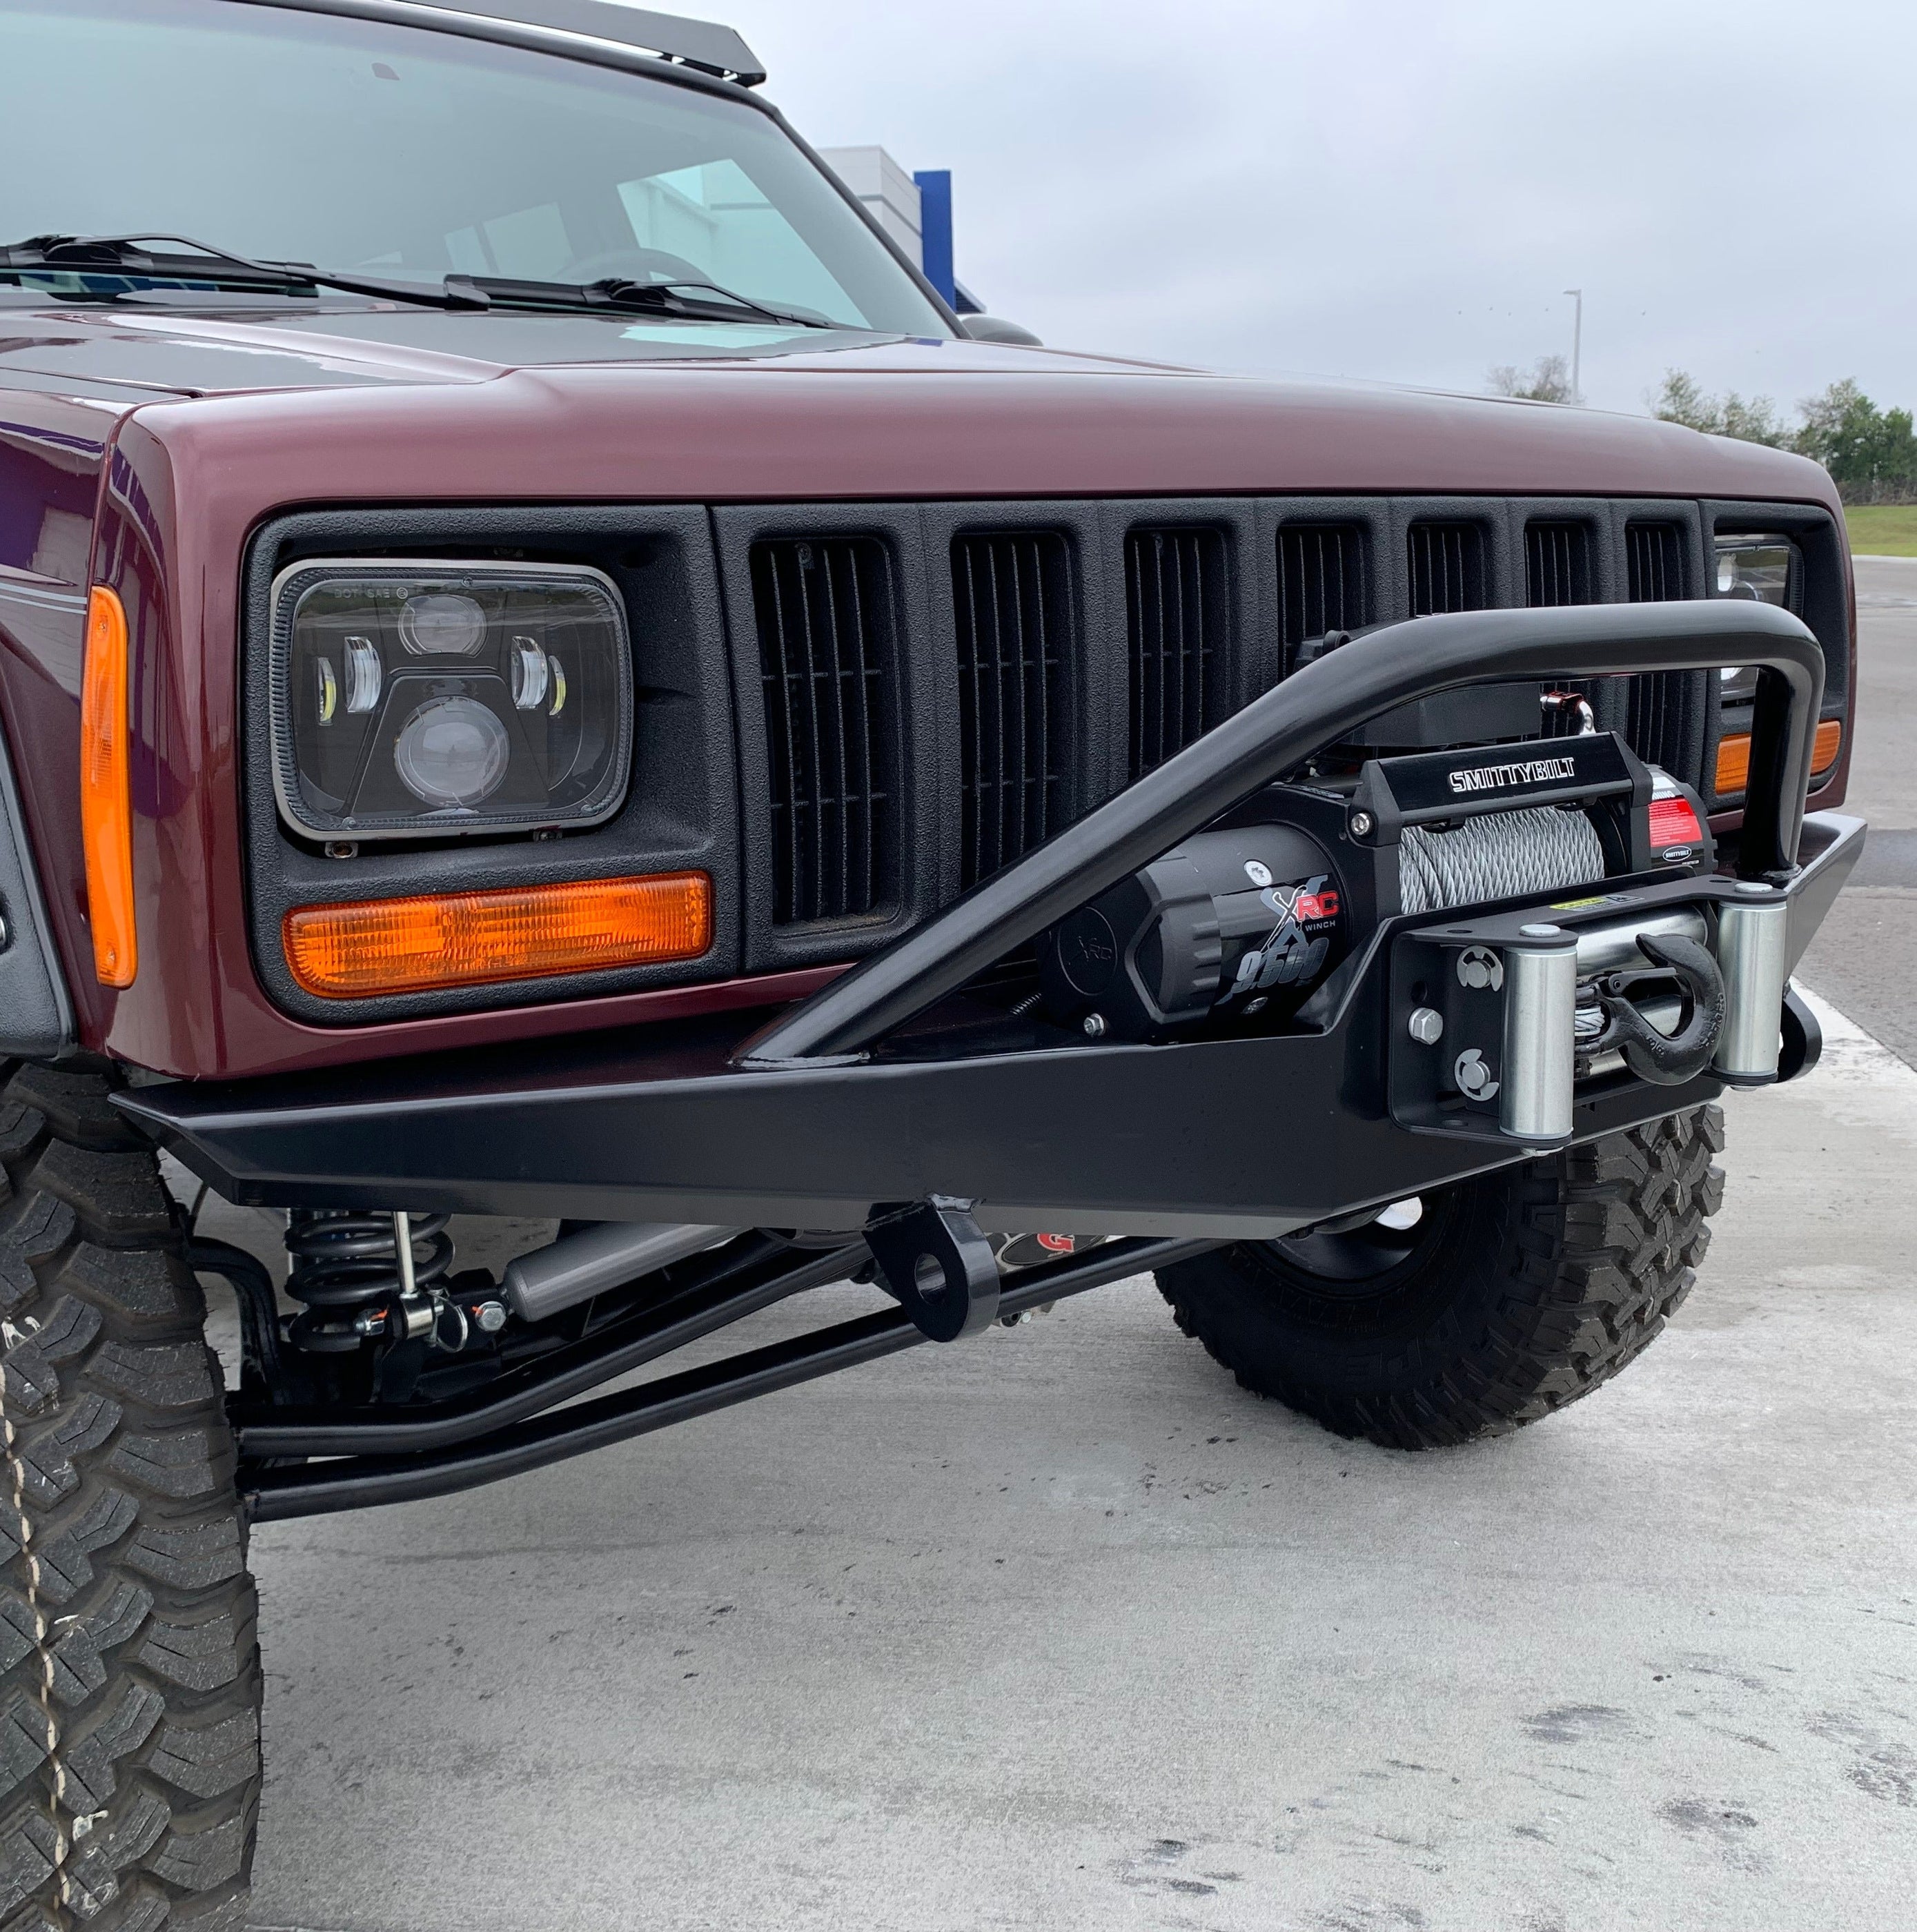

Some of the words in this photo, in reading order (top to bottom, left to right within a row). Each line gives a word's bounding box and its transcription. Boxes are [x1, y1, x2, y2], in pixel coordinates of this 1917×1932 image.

[366, 589, 390, 598] SAE
[1449, 757, 1575, 793] SMITTYBILT
[1652, 790, 1675, 800] NING
[1305, 920, 1336, 931] WINCH
